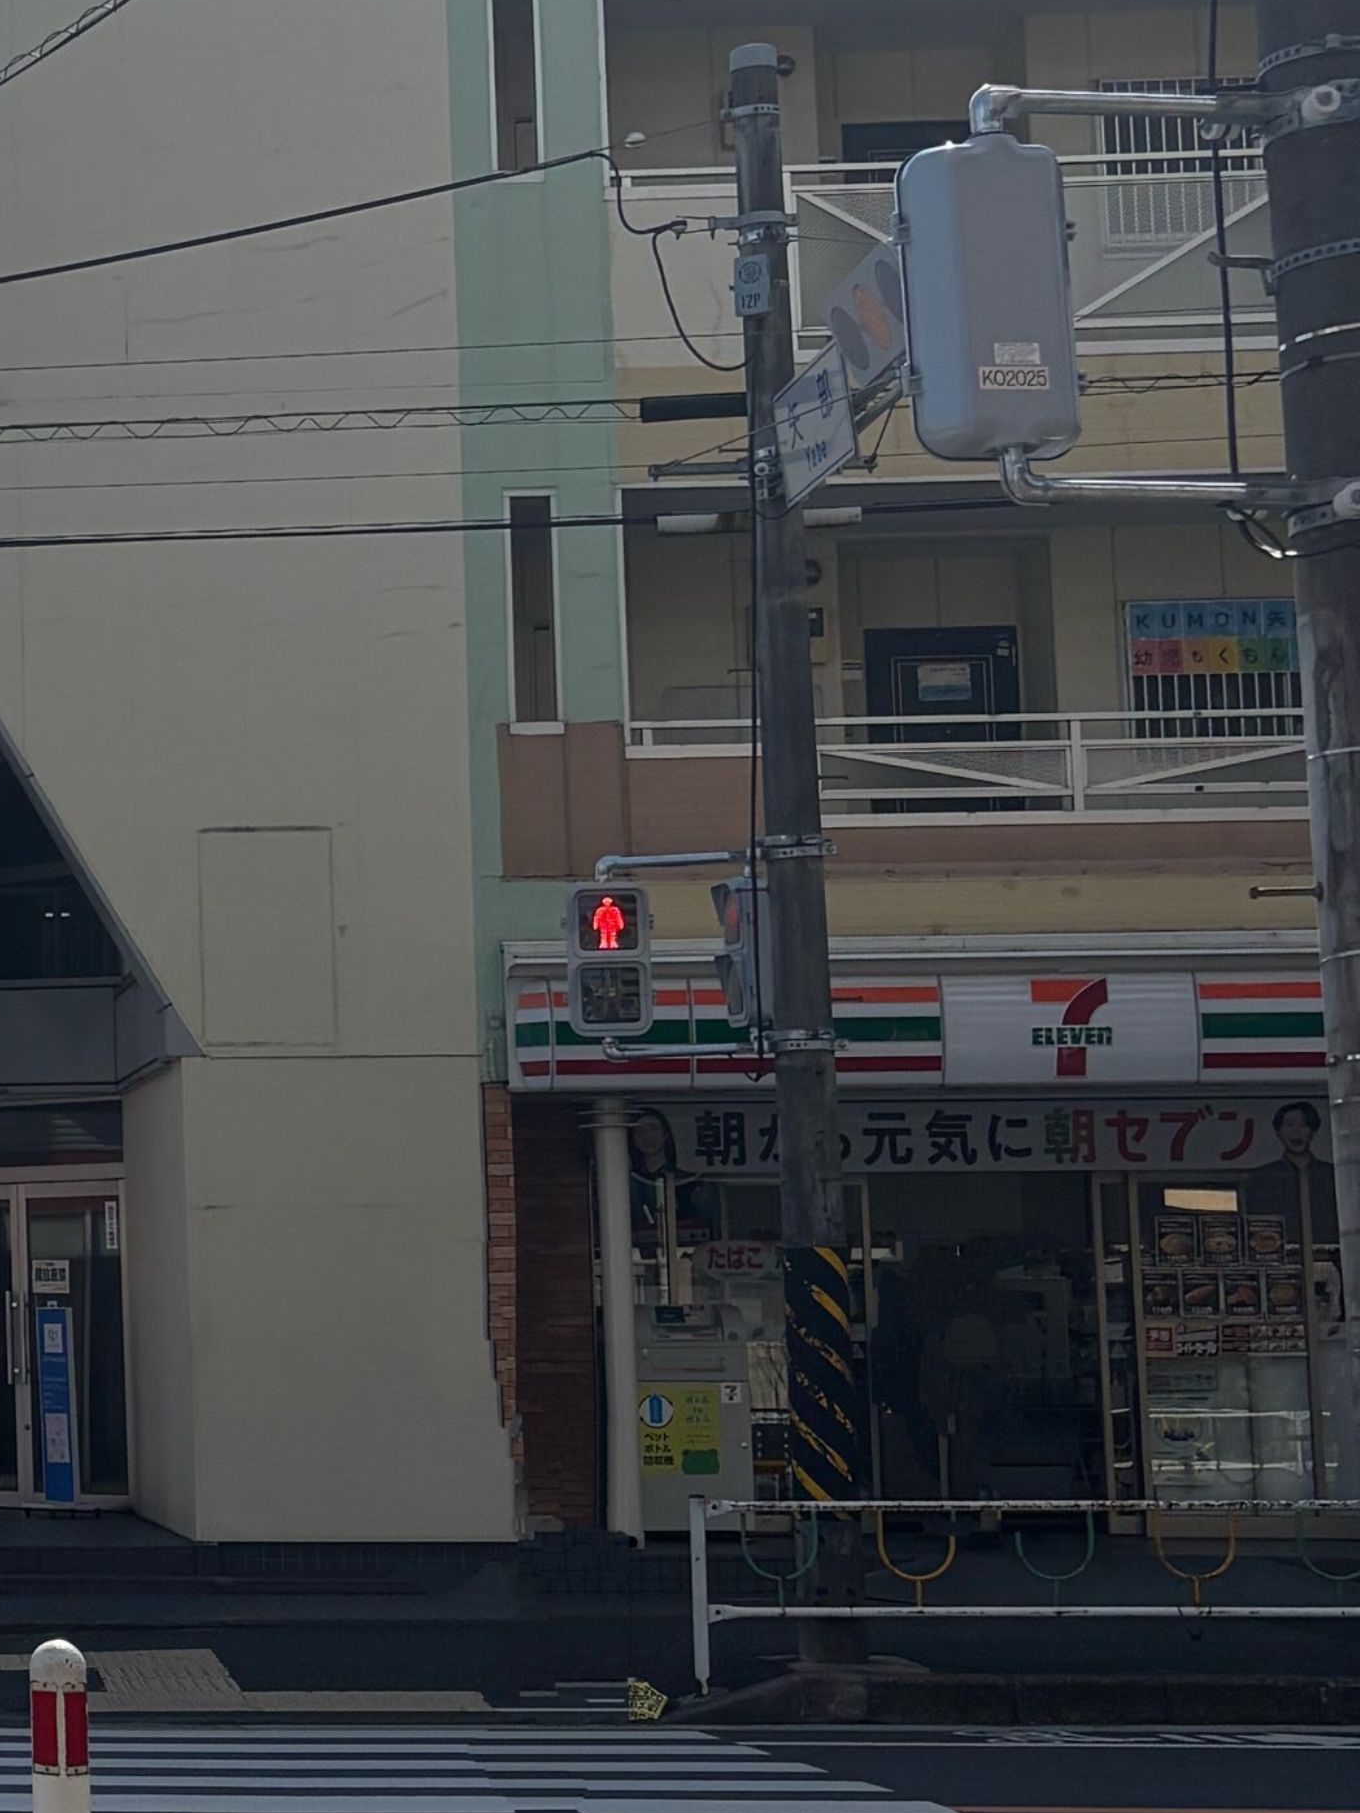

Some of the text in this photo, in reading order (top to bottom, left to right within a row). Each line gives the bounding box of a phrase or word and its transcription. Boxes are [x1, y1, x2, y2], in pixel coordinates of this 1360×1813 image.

[1136, 610, 1297, 630] KUMON矢
[694, 1105, 1255, 1167] 朝元気に朝セブン
[707, 1246, 764, 1270] たばこ
